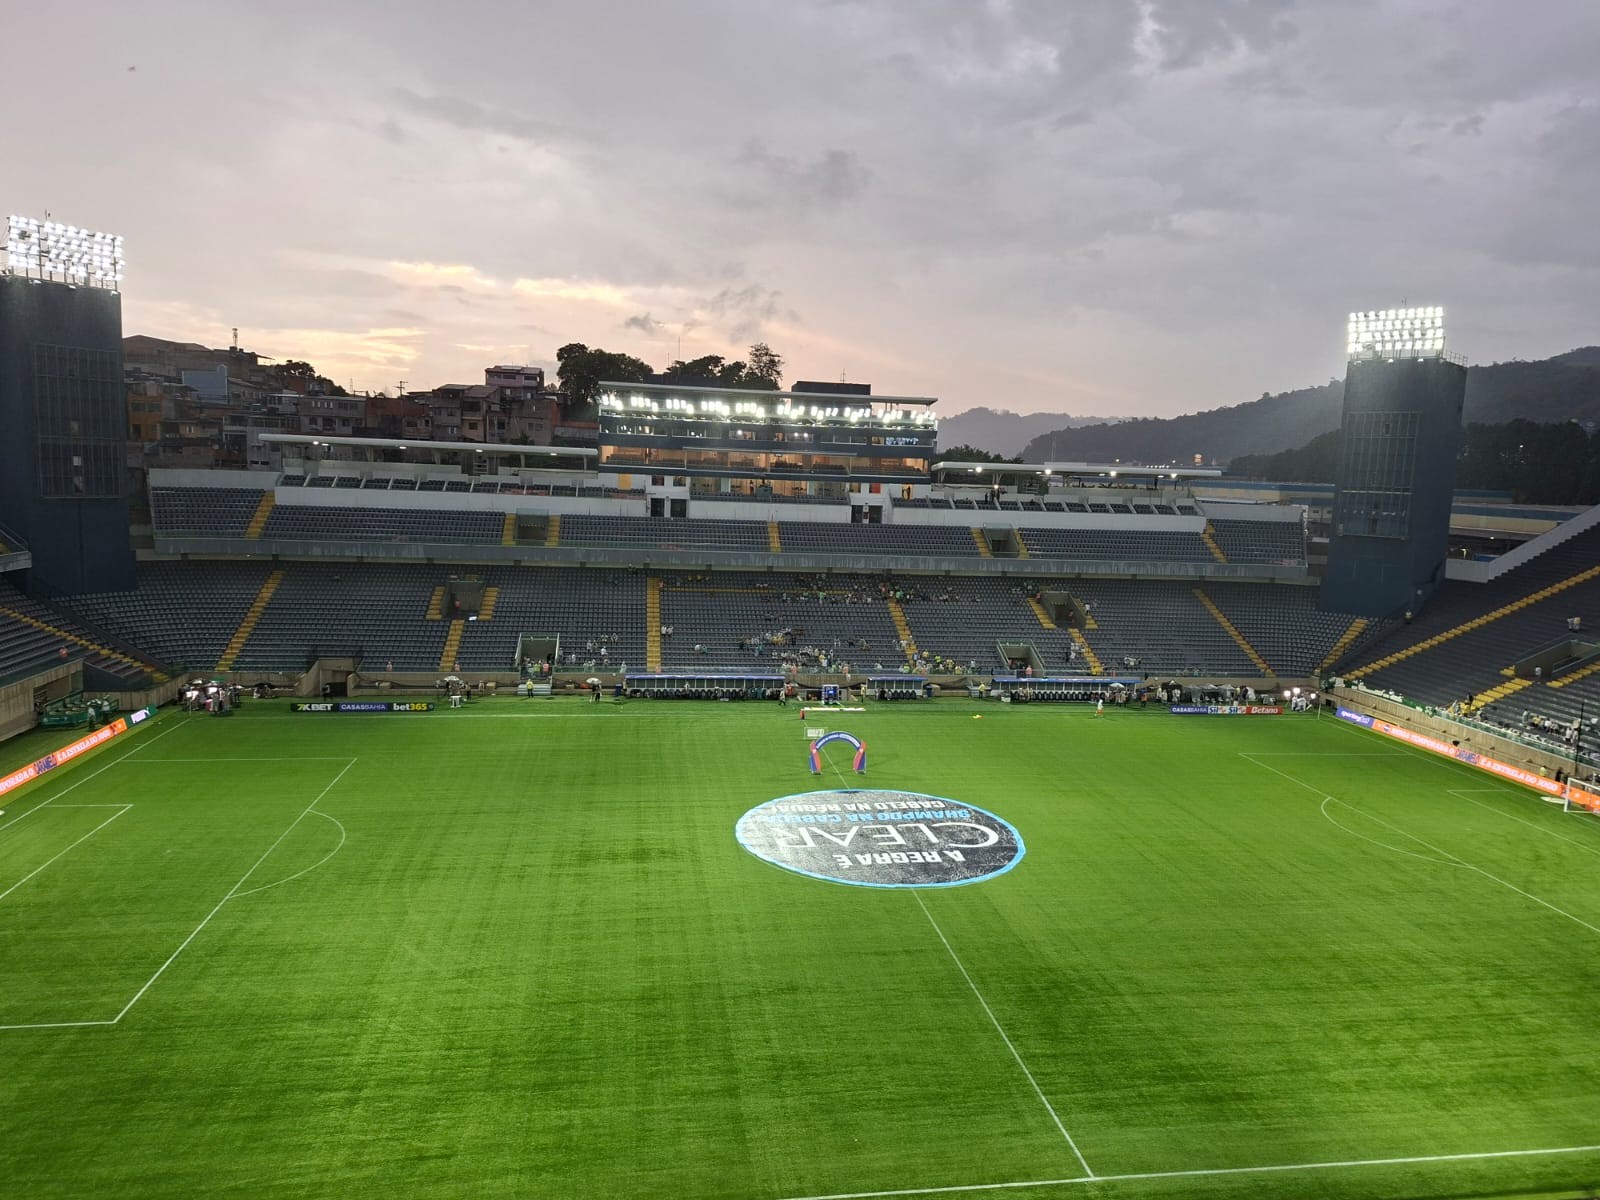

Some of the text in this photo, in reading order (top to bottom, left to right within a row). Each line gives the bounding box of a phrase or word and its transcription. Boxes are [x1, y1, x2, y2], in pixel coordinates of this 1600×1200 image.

[393, 703, 428, 711] bet365
[1251, 706, 1279, 714] Betano
[843, 802, 872, 811] NA
[874, 800, 945, 810] CABELO
[845, 812, 874, 822] NA
[878, 809, 970, 820] SHAMPOO
[770, 822, 999, 849] CLEAR
[832, 850, 966, 869] A REGRA É
